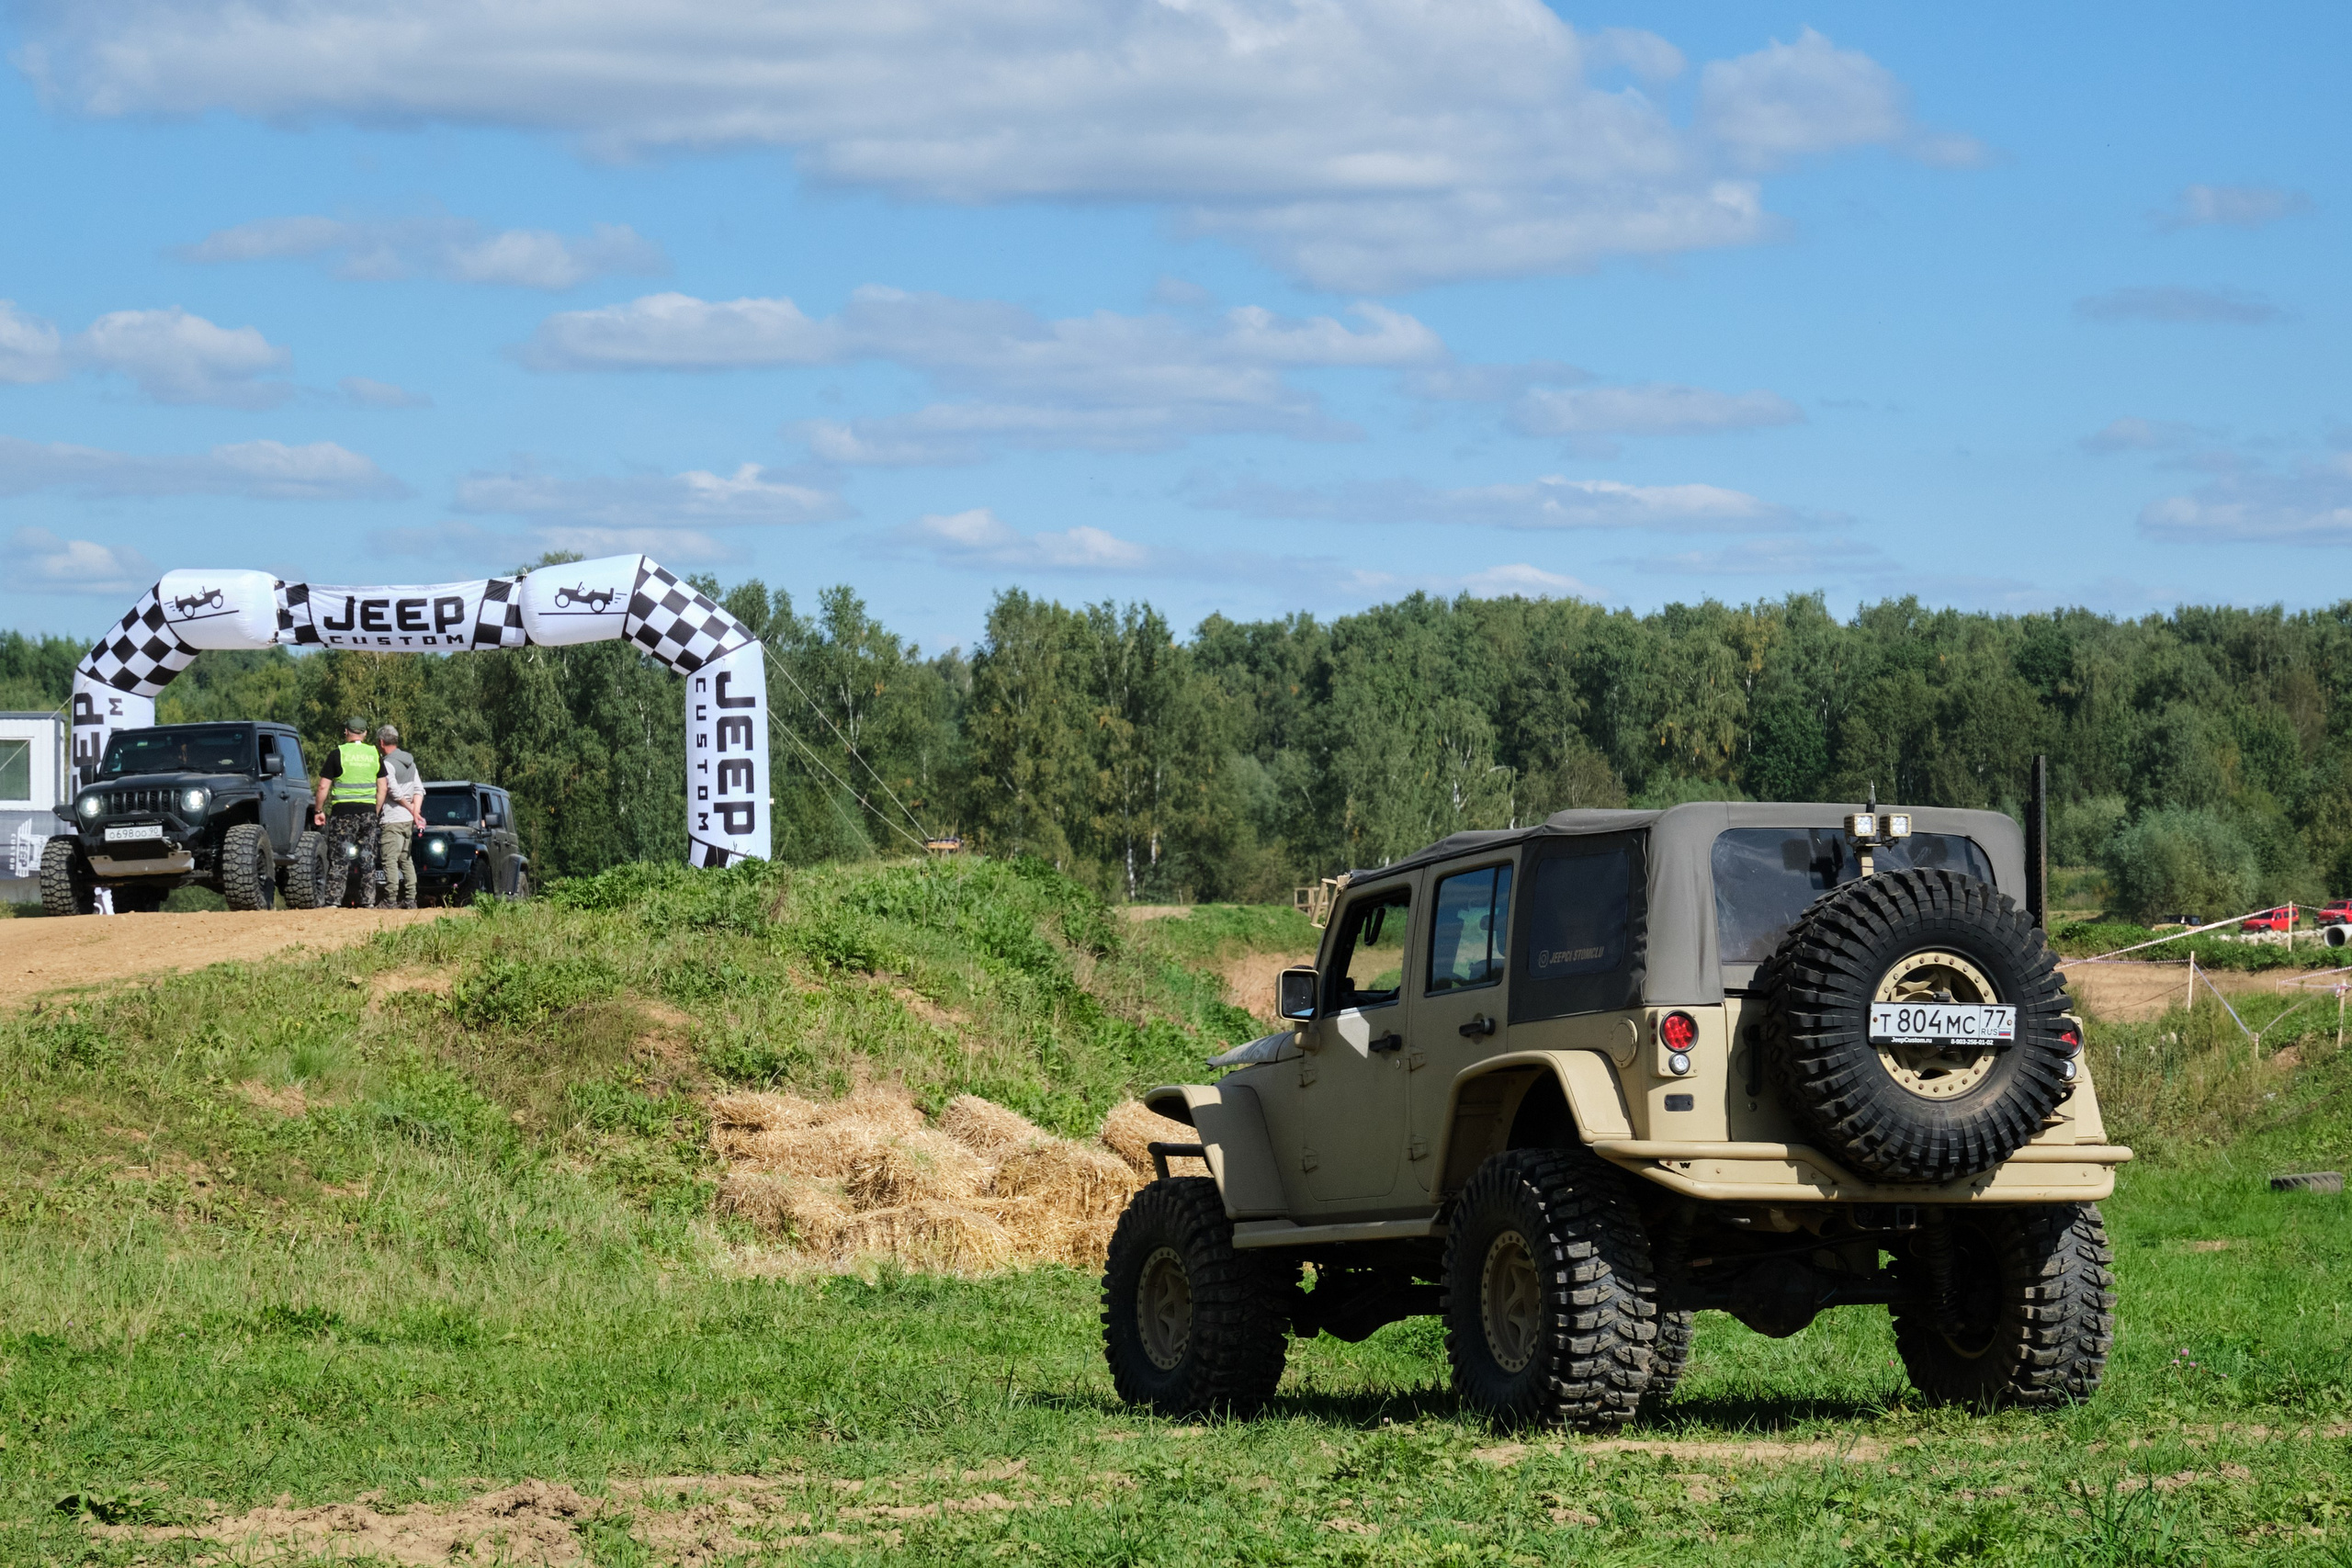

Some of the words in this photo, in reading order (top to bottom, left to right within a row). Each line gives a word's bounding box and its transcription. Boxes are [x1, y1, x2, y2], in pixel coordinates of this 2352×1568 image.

[323, 596, 465, 634] JEEP
[329, 635, 464, 645] CUSTOM
[695, 678, 708, 831] CUSTOM
[714, 671, 755, 835] JEEP
[18, 836, 29, 868] JEEP
[1981, 1028, 1998, 1036] RUS
[1984, 1010, 2007, 1029] 77
[1891, 1036, 1933, 1044] JeepCustom.ru
